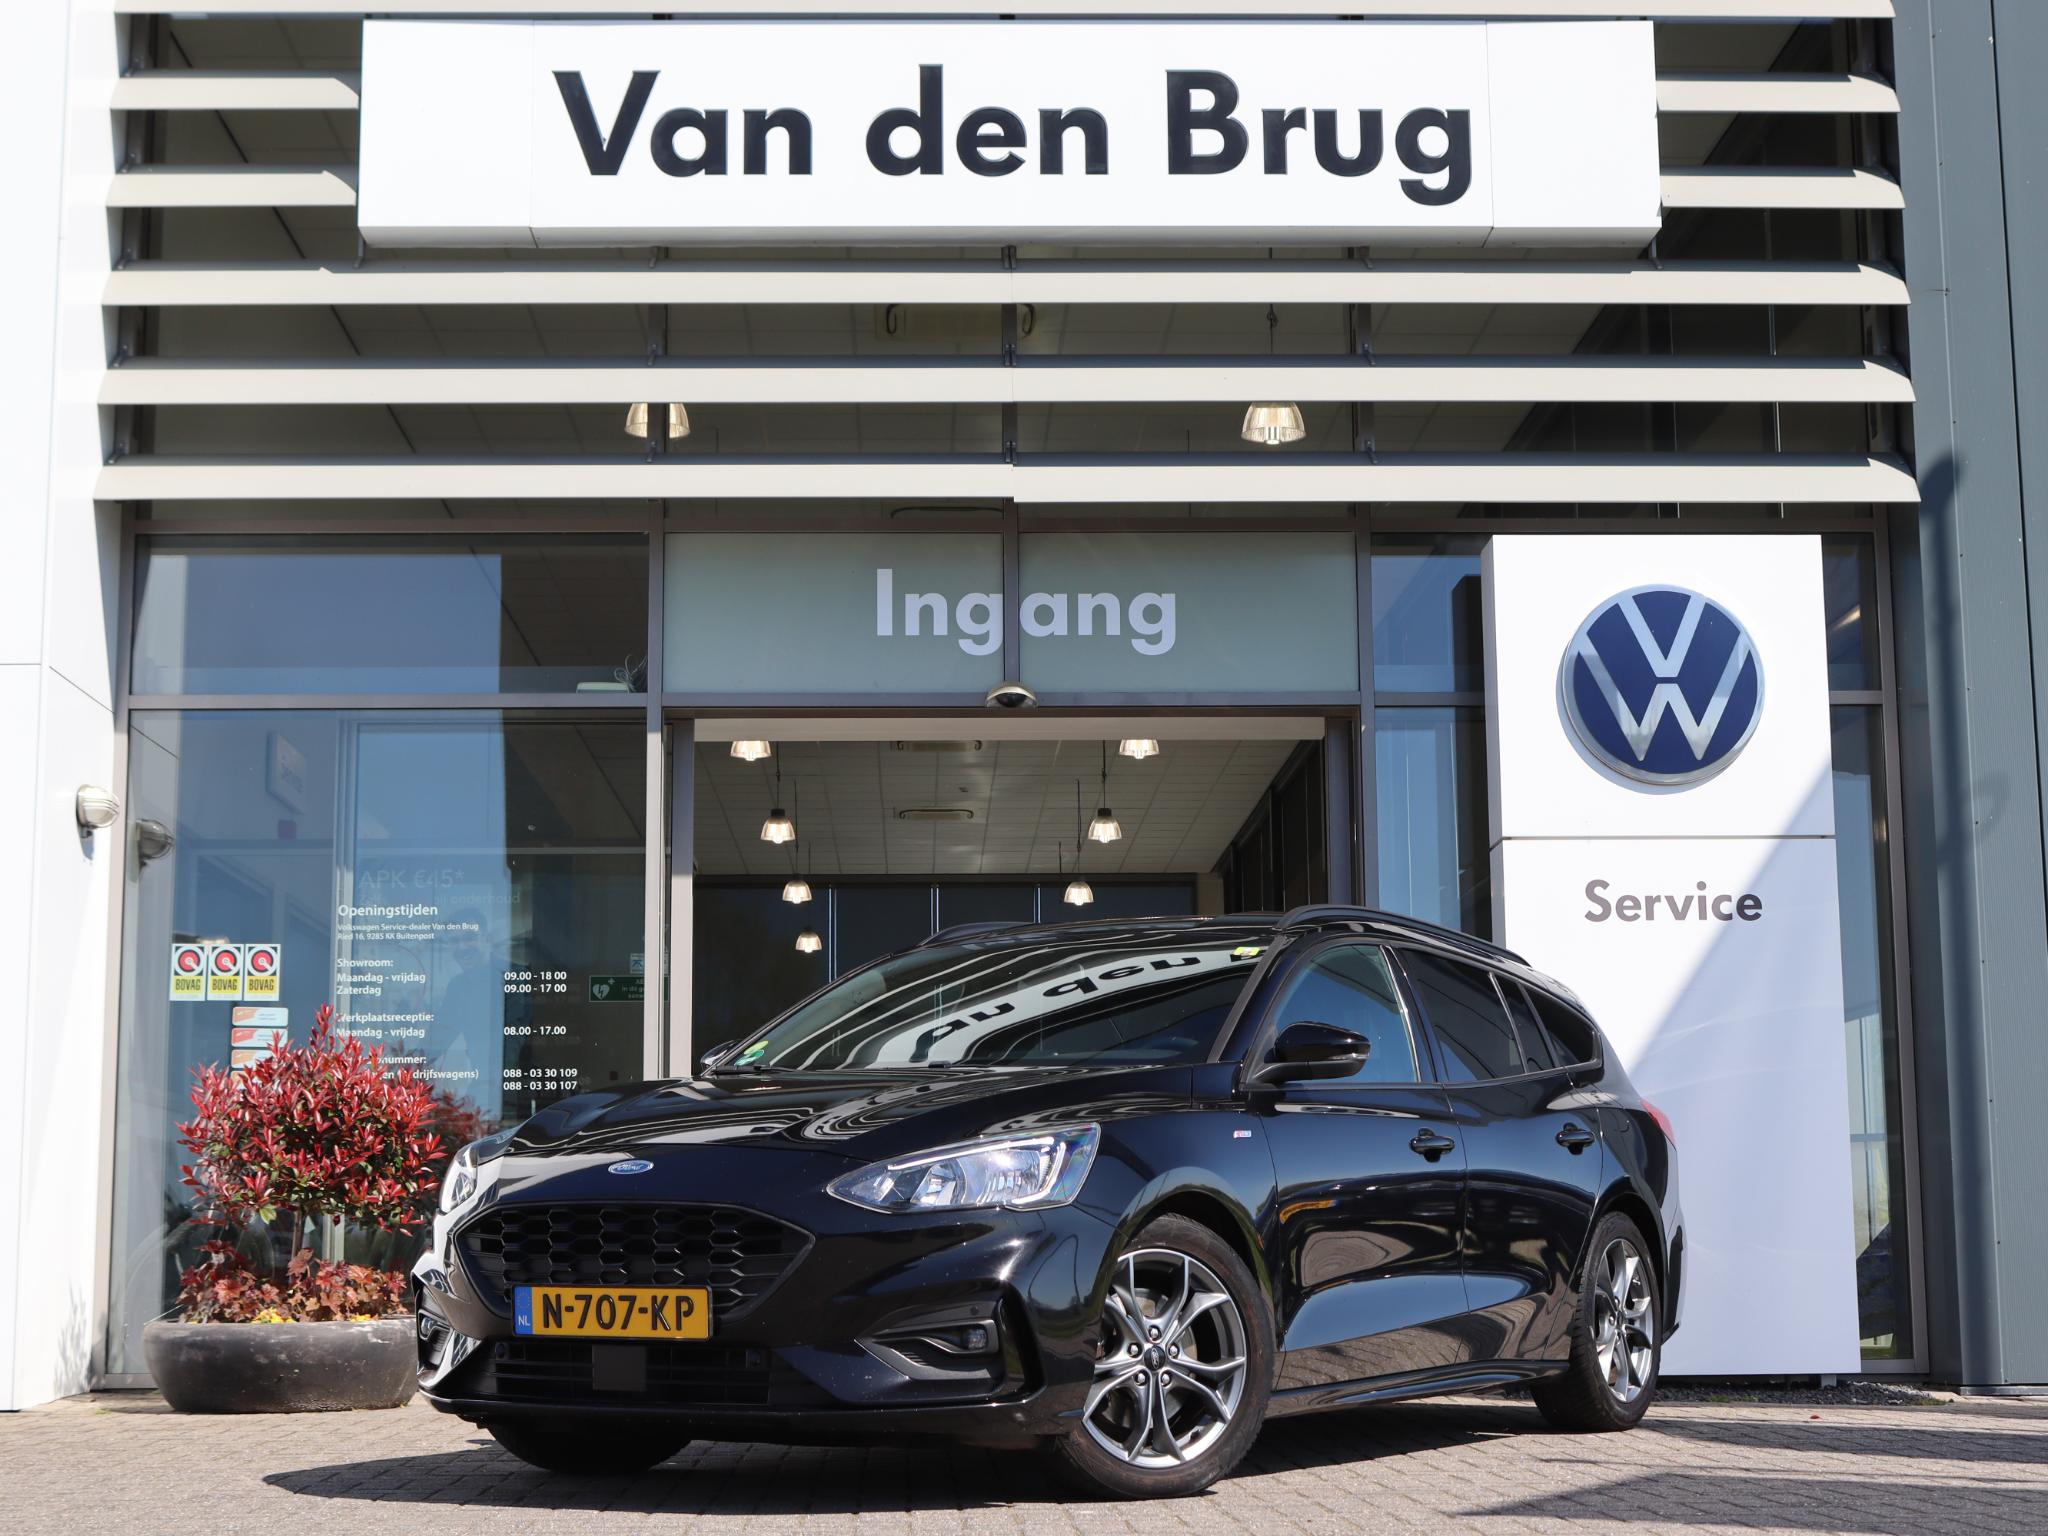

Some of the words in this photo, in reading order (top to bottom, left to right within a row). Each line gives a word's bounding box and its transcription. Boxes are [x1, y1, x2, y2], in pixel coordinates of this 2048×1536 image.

[552, 70, 813, 178] Van
[866, 64, 1109, 177] den
[1165, 69, 1472, 207] Brug
[876, 568, 1177, 656] Ingang
[1584, 878, 1763, 923] Service
[338, 904, 438, 918] Openingstijden
[337, 923, 380, 932] Volkswagen
[381, 923, 431, 931] Service-dealer
[462, 923, 479, 932] Brug
[396, 932, 435, 941] Buitenpost
[336, 958, 394, 968] Showroom:
[336, 972, 384, 984] Maandag
[391, 972, 426, 984] vrijdag
[504, 971, 532, 980] 09.00
[175, 978, 201, 991] BOVAG
[212, 978, 238, 991] BOVAG
[248, 978, 274, 991] BOVAG
[336, 985, 382, 996] Zaterdag
[504, 984, 532, 993] 09.00
[336, 1027, 383, 1039] Maandag
[390, 1027, 425, 1039] vrijdag
[503, 1026, 532, 1035] 08.00
[539, 1026, 567, 1035] 17.00
[503, 1069, 522, 1078] 088
[529, 1069, 542, 1078] 03
[544, 1069, 557, 1078] 30
[559, 1068, 578, 1077] 109
[503, 1081, 522, 1090] 088
[529, 1081, 542, 1090] 03
[544, 1081, 557, 1090] 30
[559, 1081, 578, 1090] 107
[542, 1293, 695, 1332] N-707-KP
[518, 1315, 530, 1327] NL
